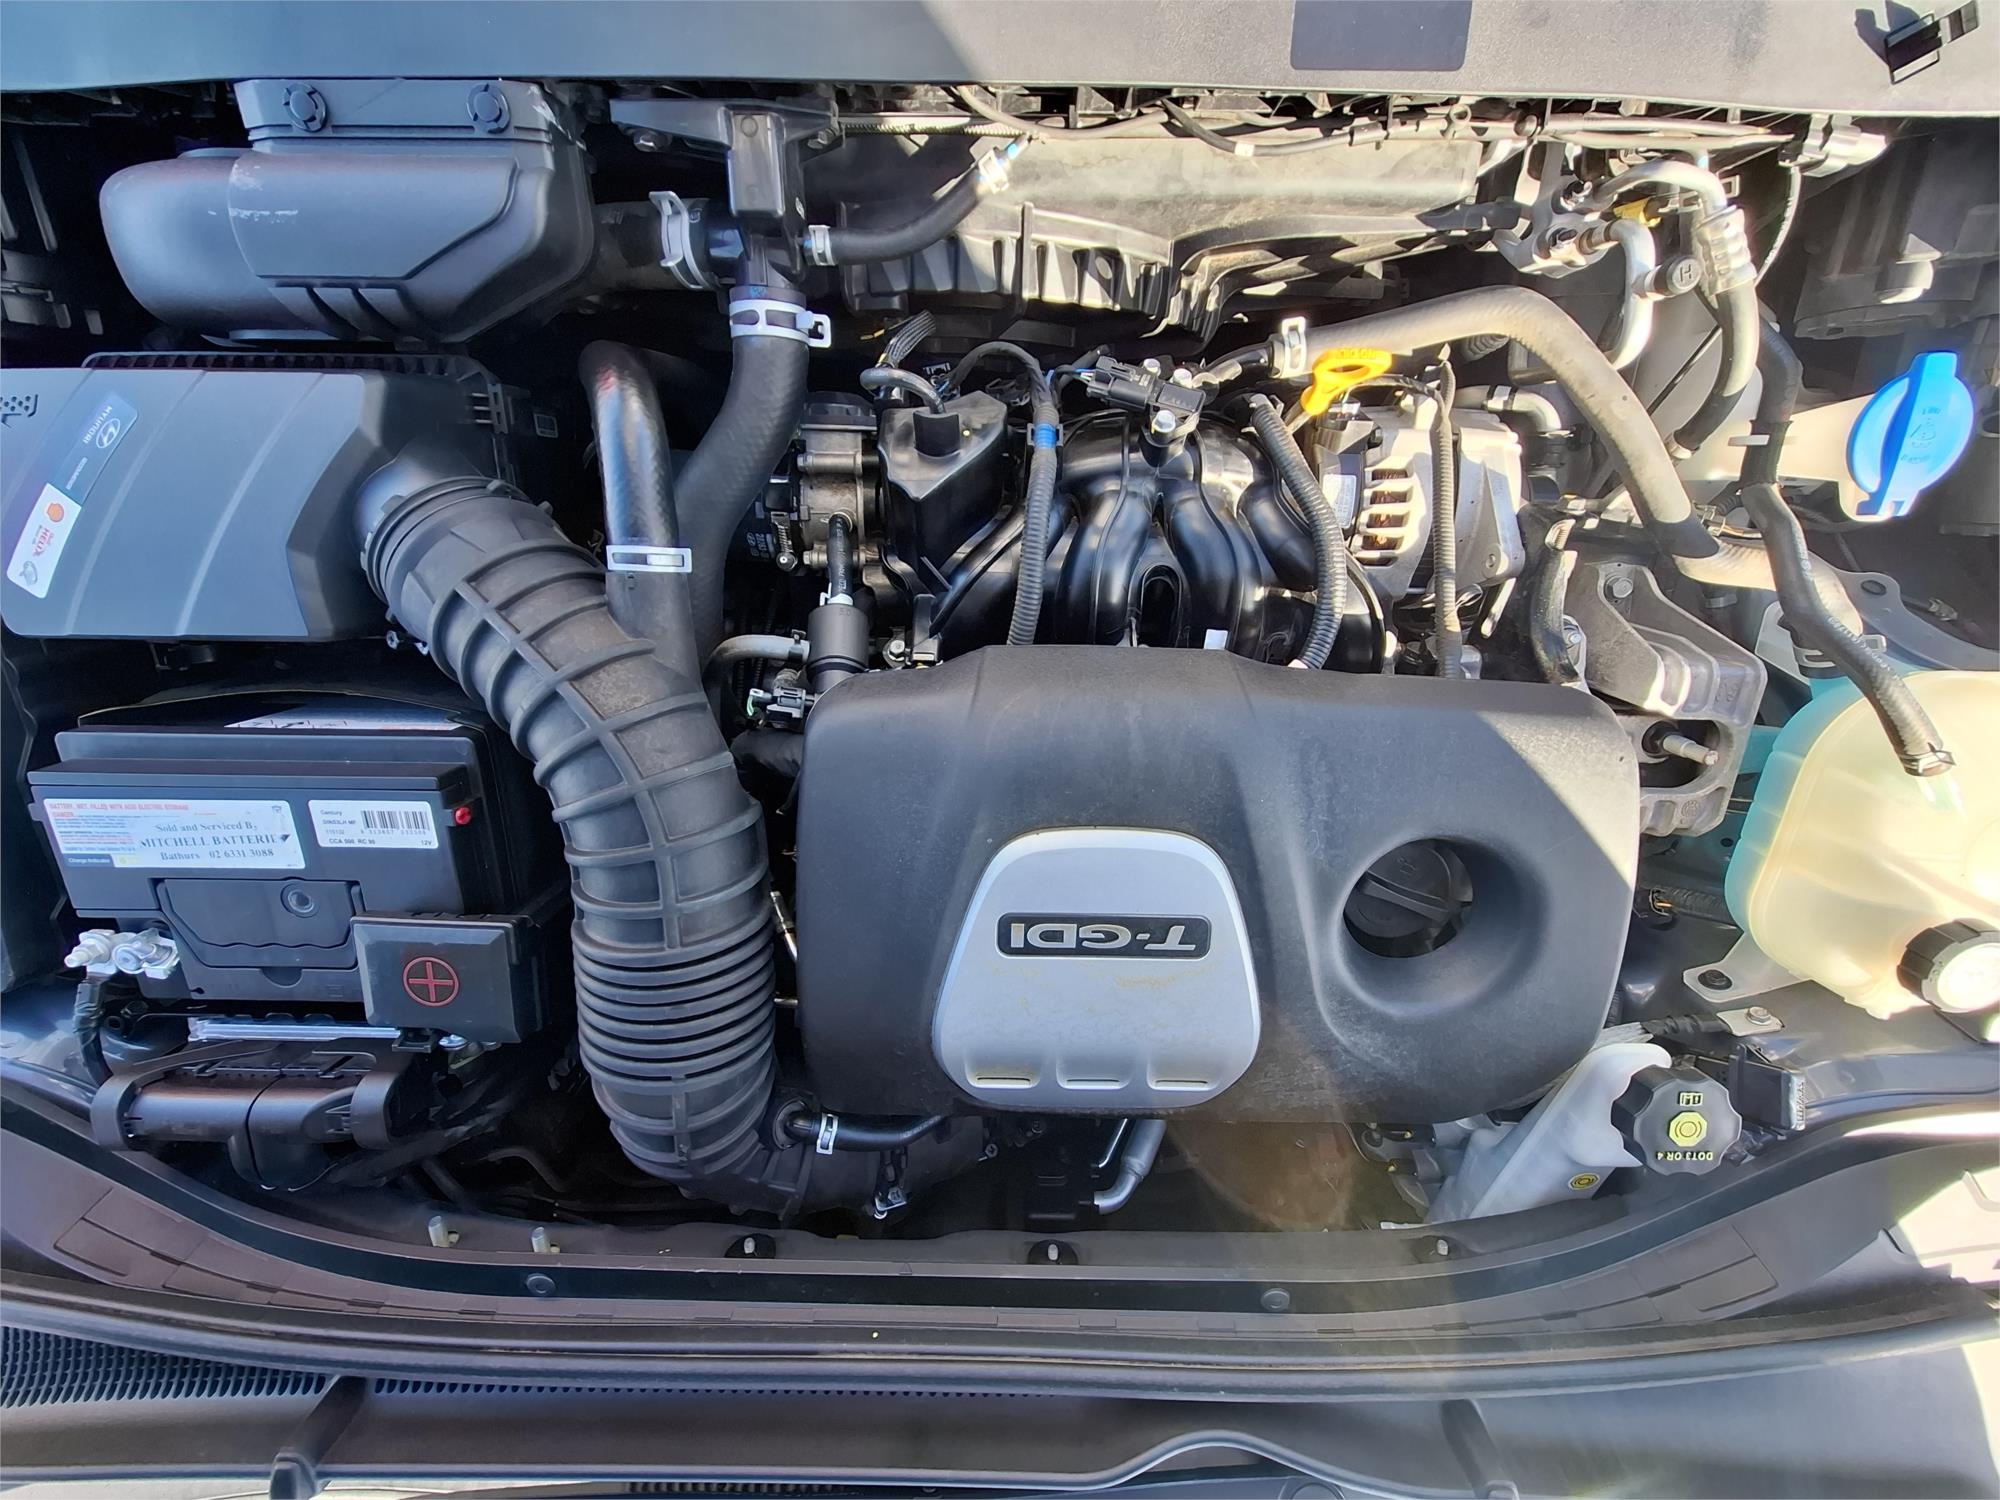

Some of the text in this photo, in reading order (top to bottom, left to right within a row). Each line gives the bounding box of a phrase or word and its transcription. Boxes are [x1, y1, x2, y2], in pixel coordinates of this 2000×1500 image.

[82, 405, 113, 444] HYUNDAI
[154, 824, 178, 832] Sold
[180, 824, 199, 832] and
[200, 821, 242, 831] Serviced
[140, 836, 209, 848] MITCHELL
[209, 850, 221, 859] 02
[224, 849, 247, 859] 6331
[250, 848, 274, 858] 3088
[1011, 922, 1197, 951] T-GDI
[1656, 1151, 1714, 1161] DOT3 OR 4
